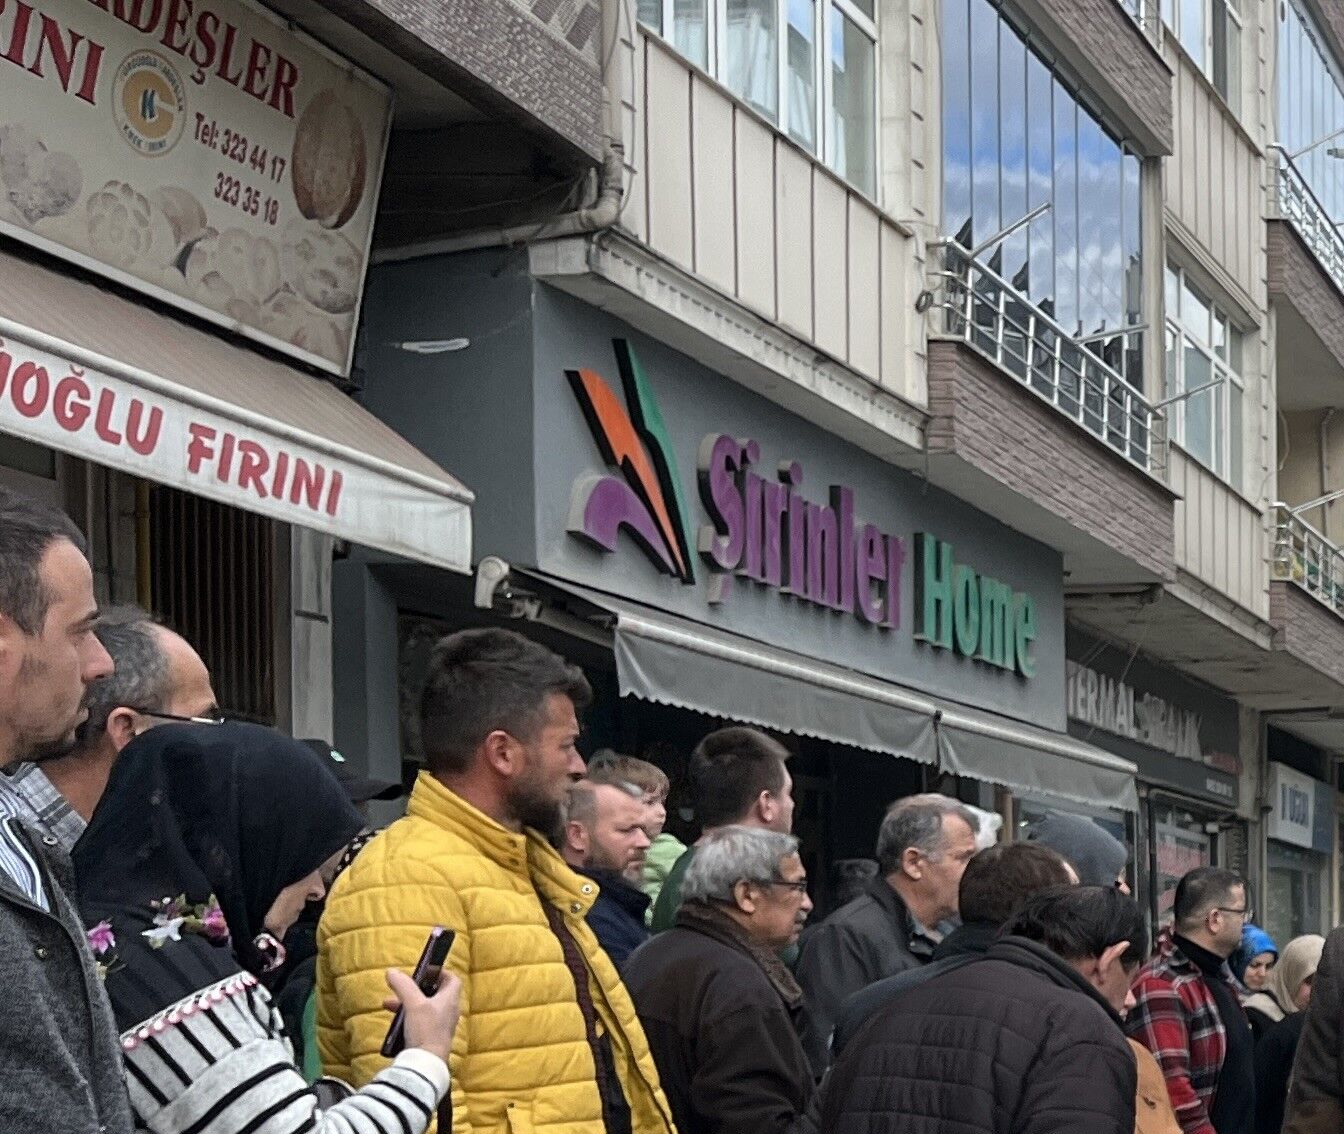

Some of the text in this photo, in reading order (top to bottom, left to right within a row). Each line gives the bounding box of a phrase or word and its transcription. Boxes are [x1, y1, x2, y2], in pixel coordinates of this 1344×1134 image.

[0, 0, 105, 105] INI
[195, 111, 287, 183] Tel: 323 44 17
[214, 171, 279, 226] 323 35 18
[0, 338, 344, 517] OĞLU FIRINI
[697, 433, 1039, 679] Şirinler Home
